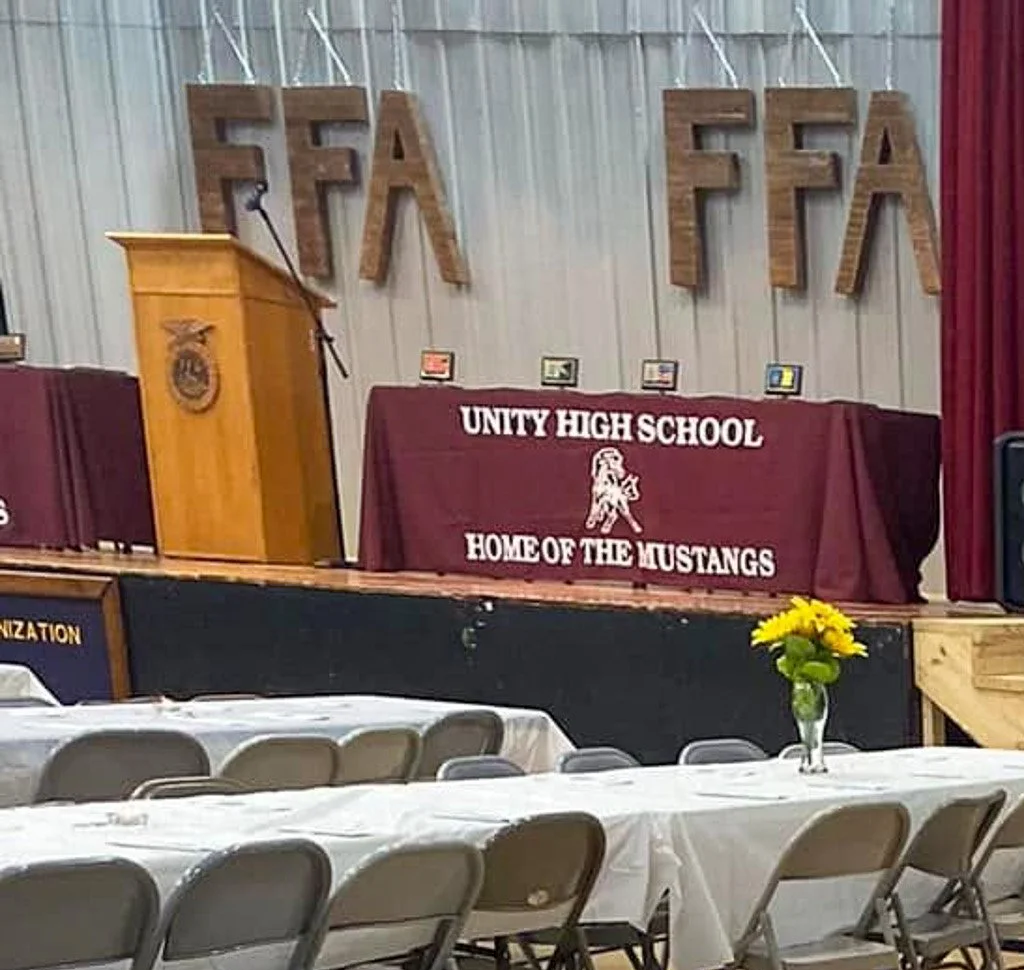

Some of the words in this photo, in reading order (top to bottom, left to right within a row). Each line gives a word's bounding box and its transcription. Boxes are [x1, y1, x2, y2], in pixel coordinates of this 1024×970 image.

[186, 84, 471, 285] FFA
[663, 87, 942, 296] FFA
[461, 405, 550, 437] UNITY
[555, 409, 633, 442] HIGH
[637, 413, 763, 448] SCHOOL
[464, 532, 541, 563] HOME
[541, 536, 577, 564] OF
[579, 538, 633, 566] THE
[637, 541, 776, 577] MUSTANGS
